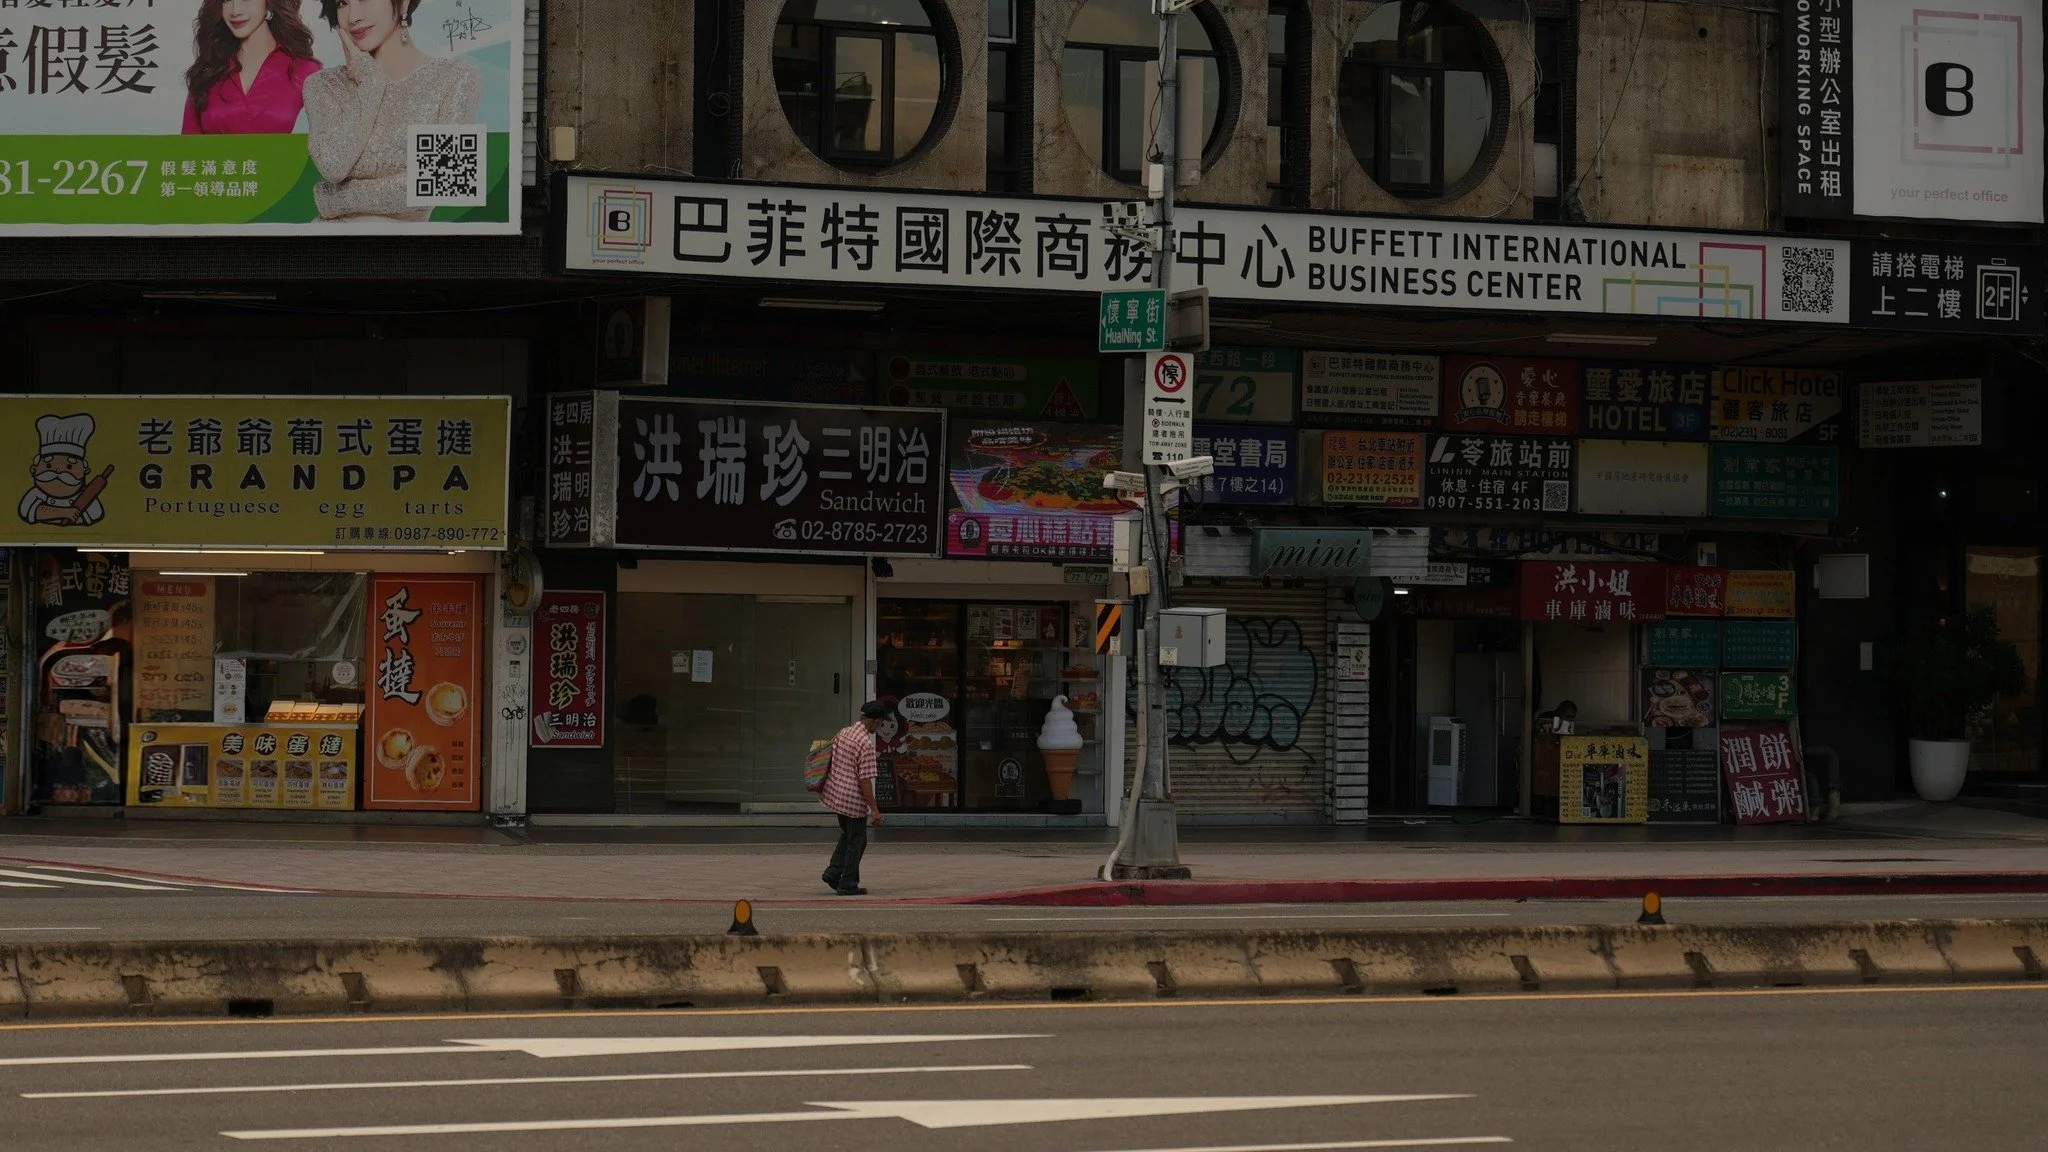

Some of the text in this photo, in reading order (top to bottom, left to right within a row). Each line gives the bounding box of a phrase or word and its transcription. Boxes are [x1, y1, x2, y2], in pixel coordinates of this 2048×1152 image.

[1818, 0, 1842, 198] 小型辦公室出租
[1925, 62, 1974, 117] B
[160, 159, 259, 177] 假髮滿意度
[1797, 124, 1812, 195] SPACE
[160, 180, 259, 198] 第一領導品牌
[1891, 187, 2009, 203] your perfect office
[609, 210, 631, 232] B
[1309, 225, 1687, 271] BUFFETT INTERNATIONAL
[1872, 251, 1965, 281] 請搭電梯
[1309, 263, 1582, 301] BUSINESS CENTER
[1871, 285, 1962, 320] 上二樓
[1985, 286, 2012, 308] 2F
[1106, 297, 1160, 326] 懷寧街
[1105, 327, 1158, 348] HuaiNing St.
[1520, 366, 1560, 390] 愛心
[1722, 368, 1842, 396] Click Hotel
[1195, 375, 1257, 416] 72
[552, 400, 592, 428] 老四房
[1589, 404, 1697, 433] HOTEL 3F
[137, 417, 473, 458] 老爺爺葡式蛋撻
[1818, 424, 1840, 442] 5F
[632, 412, 931, 508] 洪瑞珍 三明治
[1167, 453, 1184, 461] 110
[1460, 437, 1571, 470] 苓旅站前
[138, 463, 471, 491] GRANDPA
[573, 439, 591, 533] 三明治
[1327, 472, 1415, 486] 02-2312-2525
[1430, 467, 1569, 479] LININN MAIN STATION
[552, 438, 573, 538] 洪瑞珍
[1511, 481, 1529, 494] 4F
[144, 496, 465, 519] Portuguese egg tarts
[820, 489, 927, 514] Sandwich
[1427, 495, 1541, 512] 0907-551-203
[801, 520, 929, 545] 02-8785-2723
[1270, 538, 1361, 570] mini
[157, 584, 192, 595] MENU
[1553, 564, 1633, 598] 洪小姐
[513, 616, 523, 625] 72
[549, 604, 580, 615] 老四房
[1543, 598, 1638, 622] 車庫滷味
[430, 619, 467, 629] Souvenir
[377, 585, 424, 707] 蛋撻
[550, 622, 581, 711] 洪瑞珍
[905, 697, 944, 710] 歡迎光臨
[1778, 675, 1790, 709] 3F
[549, 712, 597, 728] 三明治
[222, 733, 345, 756] 美味蛋撻
[551, 731, 597, 741] Sandwich
[1721, 732, 1792, 775] 潤餅
[1732, 777, 1804, 820] 鹹粥
